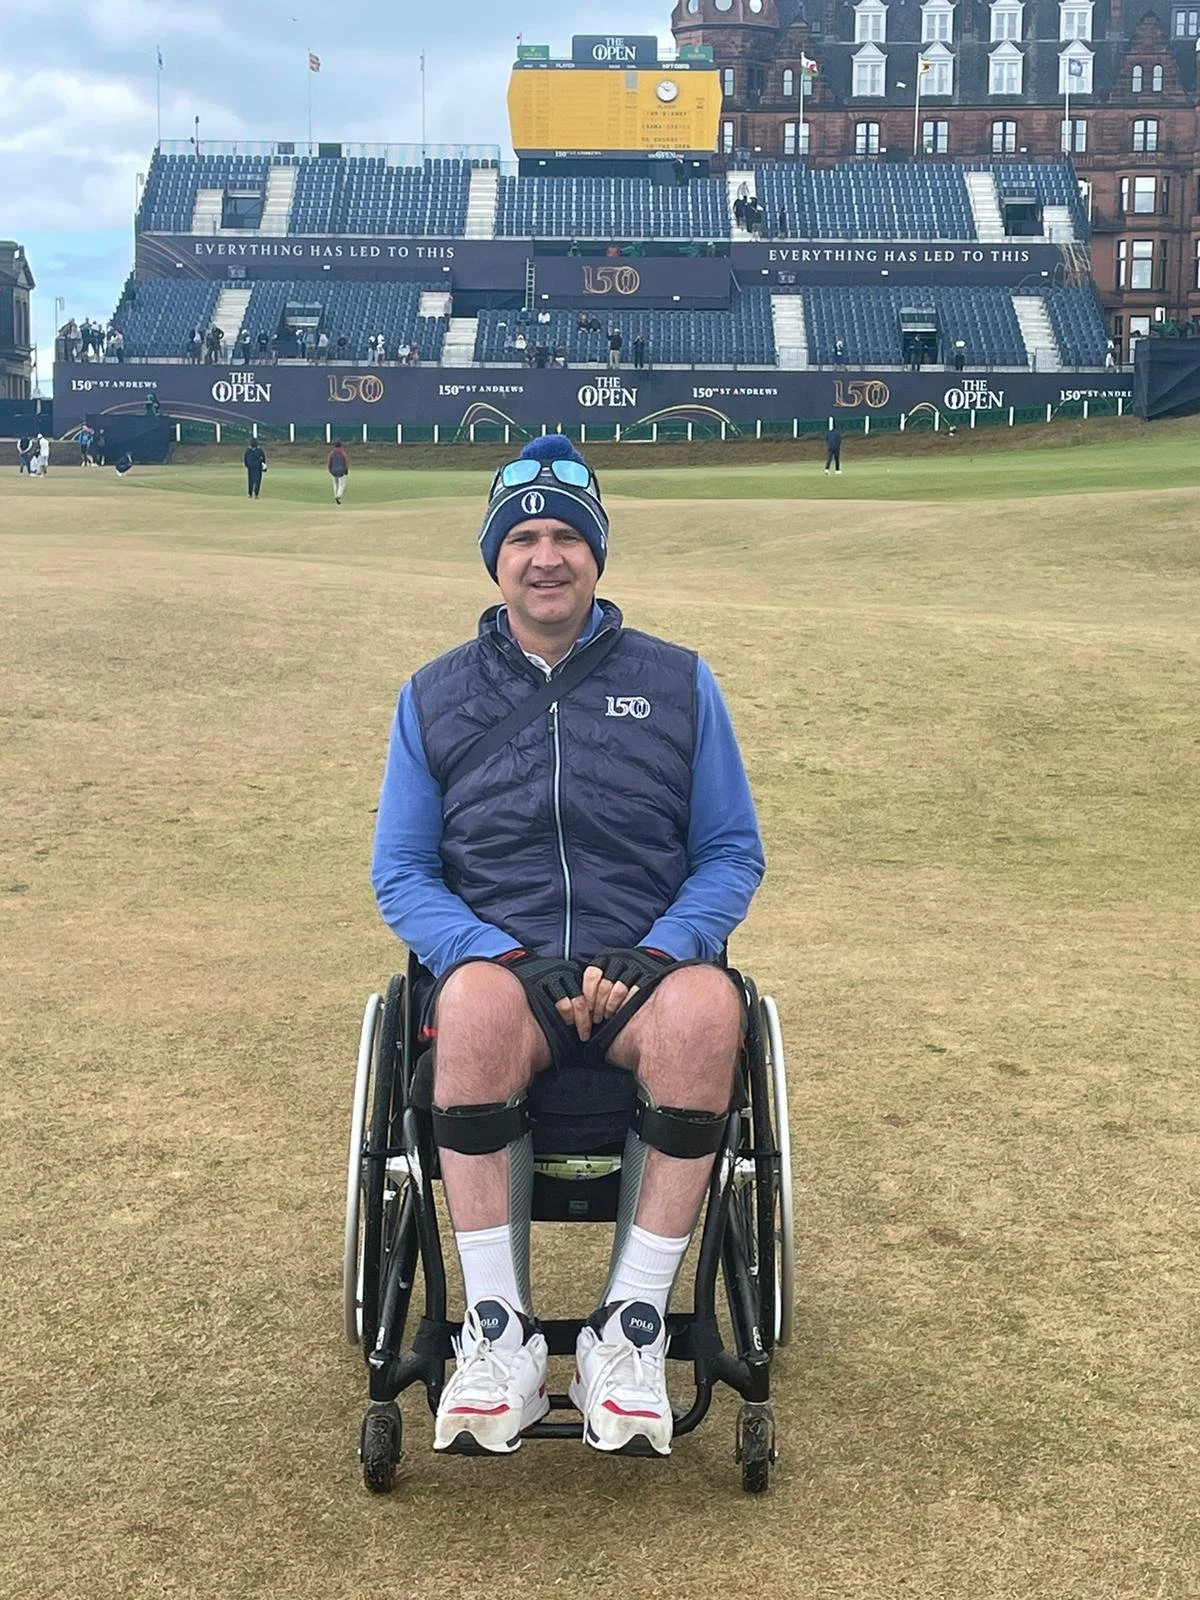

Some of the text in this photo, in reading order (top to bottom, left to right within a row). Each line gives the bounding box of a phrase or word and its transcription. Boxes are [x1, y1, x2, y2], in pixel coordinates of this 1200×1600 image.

[605, 37, 624, 47] THE
[592, 44, 637, 61] OPEN
[195, 243, 456, 259] EVERYTHING HAS LED TO THIS
[769, 249, 1030, 263] EVERYTHING HAS LED TO THIS
[581, 265, 640, 295] 150
[112, 381, 158, 389] ANDREWS
[229, 372, 255, 384] THE
[595, 376, 621, 388] THE
[962, 379, 987, 391] THE
[211, 380, 271, 402] OPEN
[327, 374, 384, 403] 150
[466, 385, 477, 393] ST
[479, 385, 524, 393] ANDREWS
[720, 388, 731, 396] ST
[733, 388, 778, 396] ANDREWS
[832, 380, 890, 409] 150
[1087, 390, 1099, 398] ST
[1101, 390, 1133, 398] ANDRE
[577, 385, 637, 407] OPEN
[943, 388, 1004, 410] OPEN
[605, 696, 651, 719] 150
[480, 1317, 499, 1327] OLO
[630, 1317, 654, 1331] POLO
